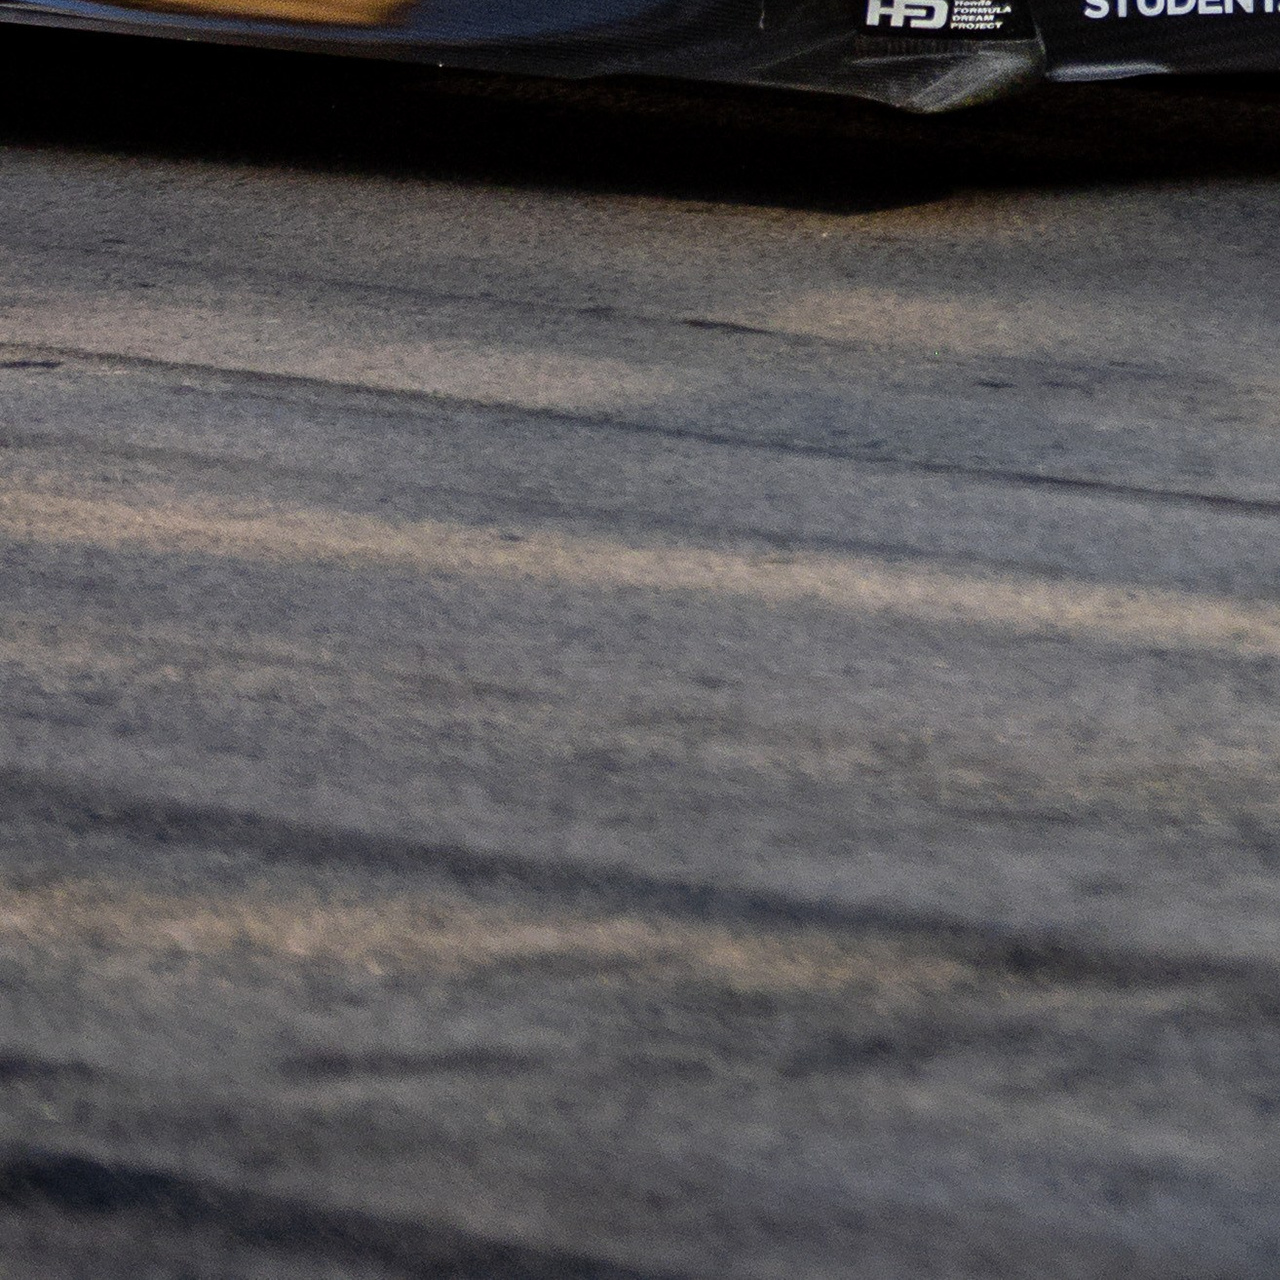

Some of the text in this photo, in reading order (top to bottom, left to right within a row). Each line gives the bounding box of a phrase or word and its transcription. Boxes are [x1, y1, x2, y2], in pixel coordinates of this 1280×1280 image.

[952, 6, 1013, 15] FORMULA
[951, 14, 995, 22] DREAM
[950, 21, 1004, 31] PROJECT
